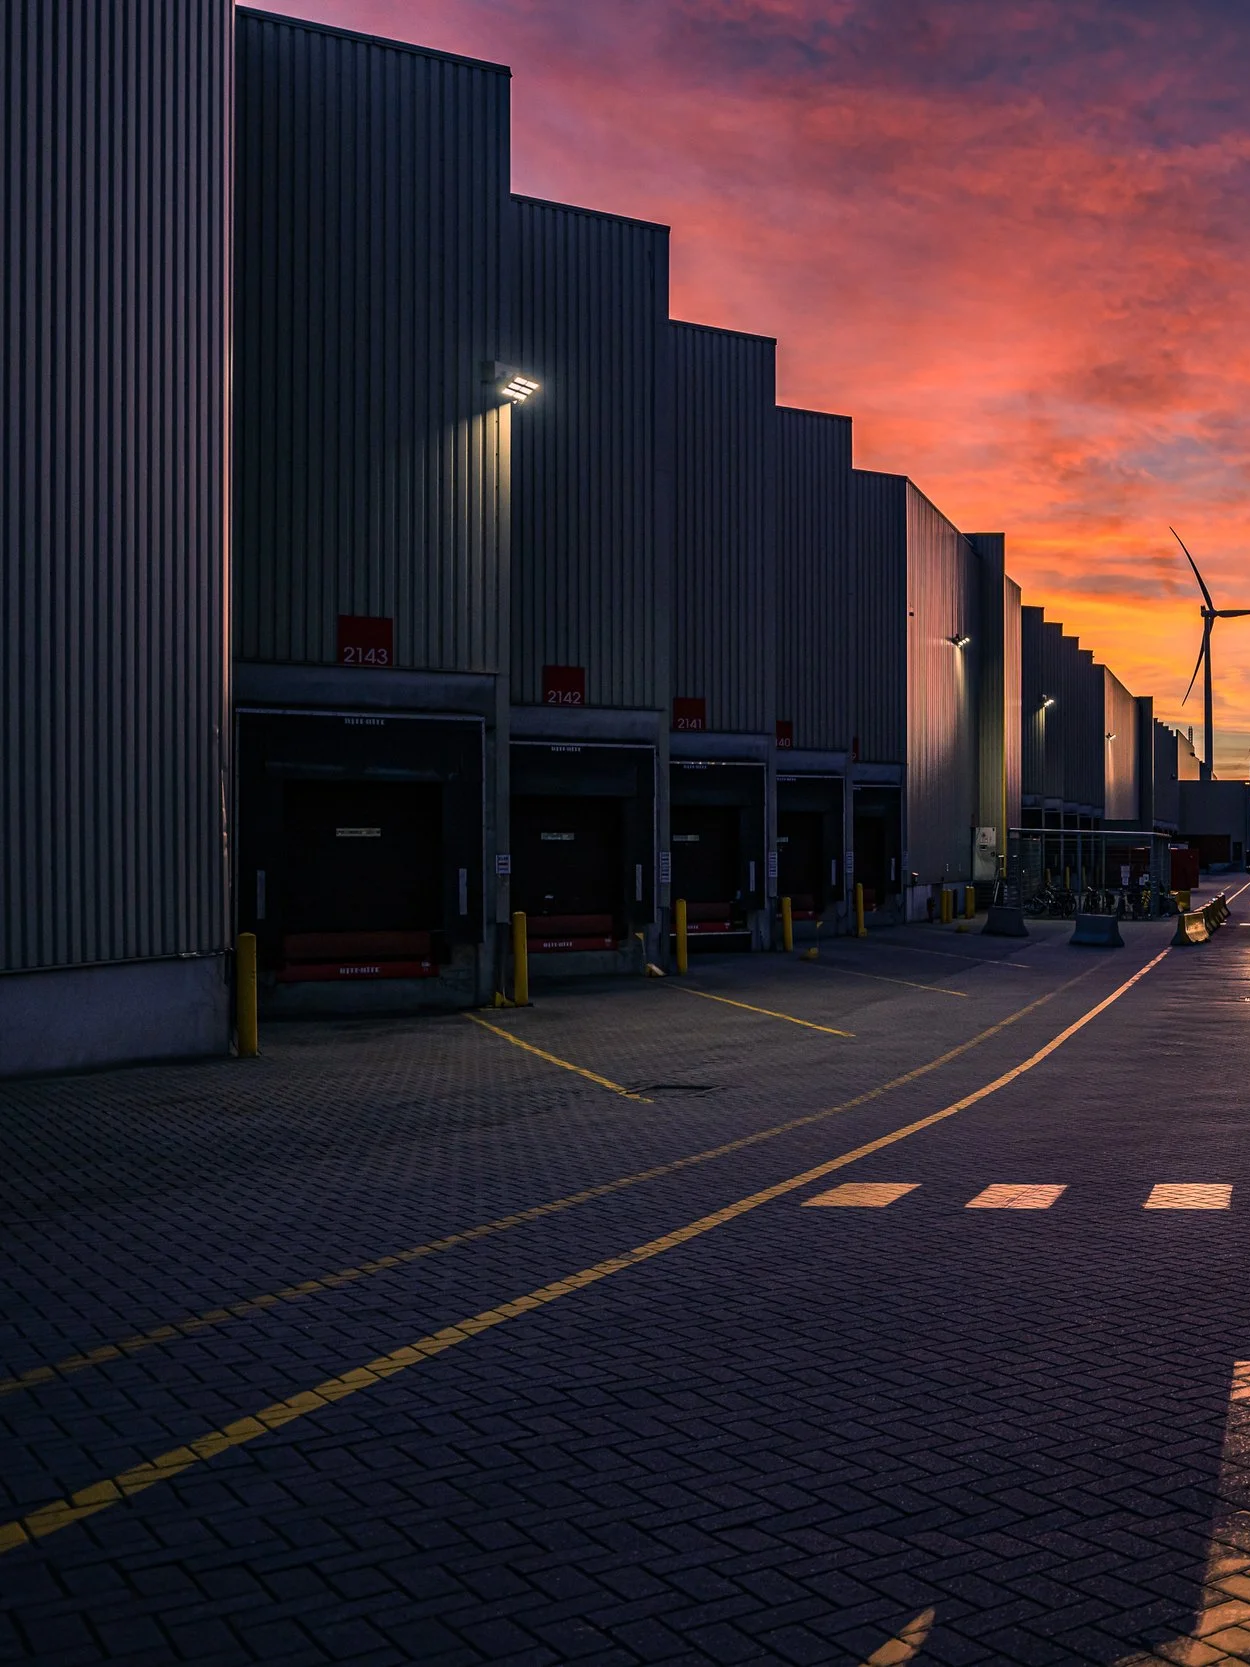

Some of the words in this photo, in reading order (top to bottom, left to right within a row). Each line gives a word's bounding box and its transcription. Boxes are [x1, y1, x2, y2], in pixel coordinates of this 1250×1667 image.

[343, 646, 389, 665] 2143
[547, 690, 582, 705] 2142
[677, 717, 702, 729] 2141
